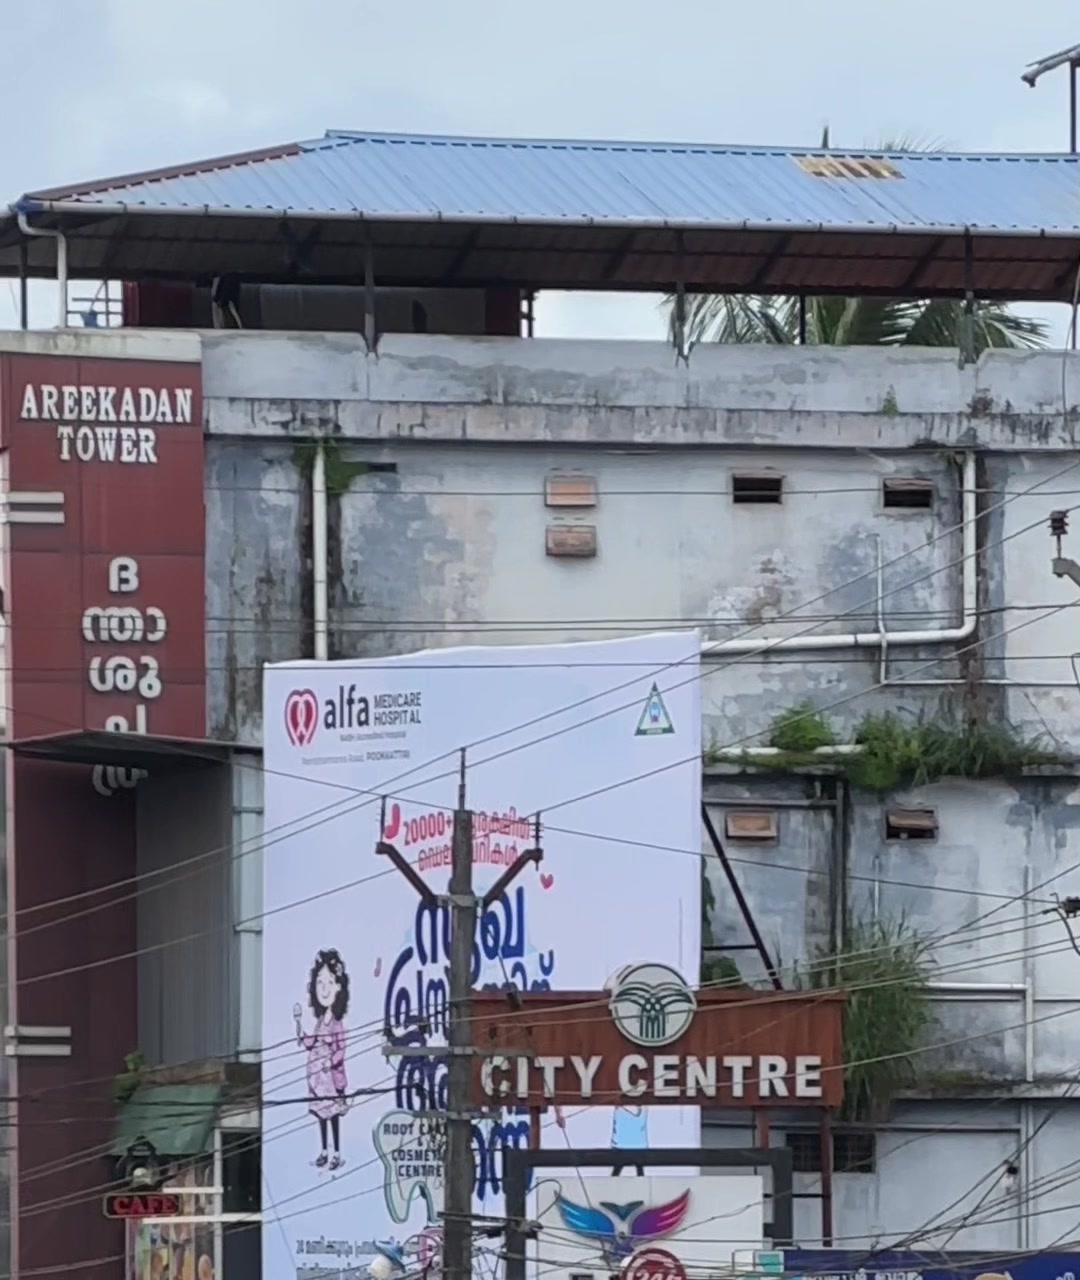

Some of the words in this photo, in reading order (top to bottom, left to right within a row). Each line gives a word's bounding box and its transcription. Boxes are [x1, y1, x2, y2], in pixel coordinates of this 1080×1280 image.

[20, 383, 193, 424] AREEKADAN
[57, 425, 159, 464] TOWER
[324, 684, 370, 729] alfa
[374, 692, 422, 709] MEDICARE
[374, 709, 422, 727] HOSPITAL
[481, 1055, 603, 1098] CITY
[618, 1054, 823, 1098] CENTRE
[383, 1123, 414, 1135] ROOT
[391, 1149, 447, 1162] COSMET
[398, 1165, 442, 1177] CENTRE
[113, 1195, 178, 1214] CAFE
